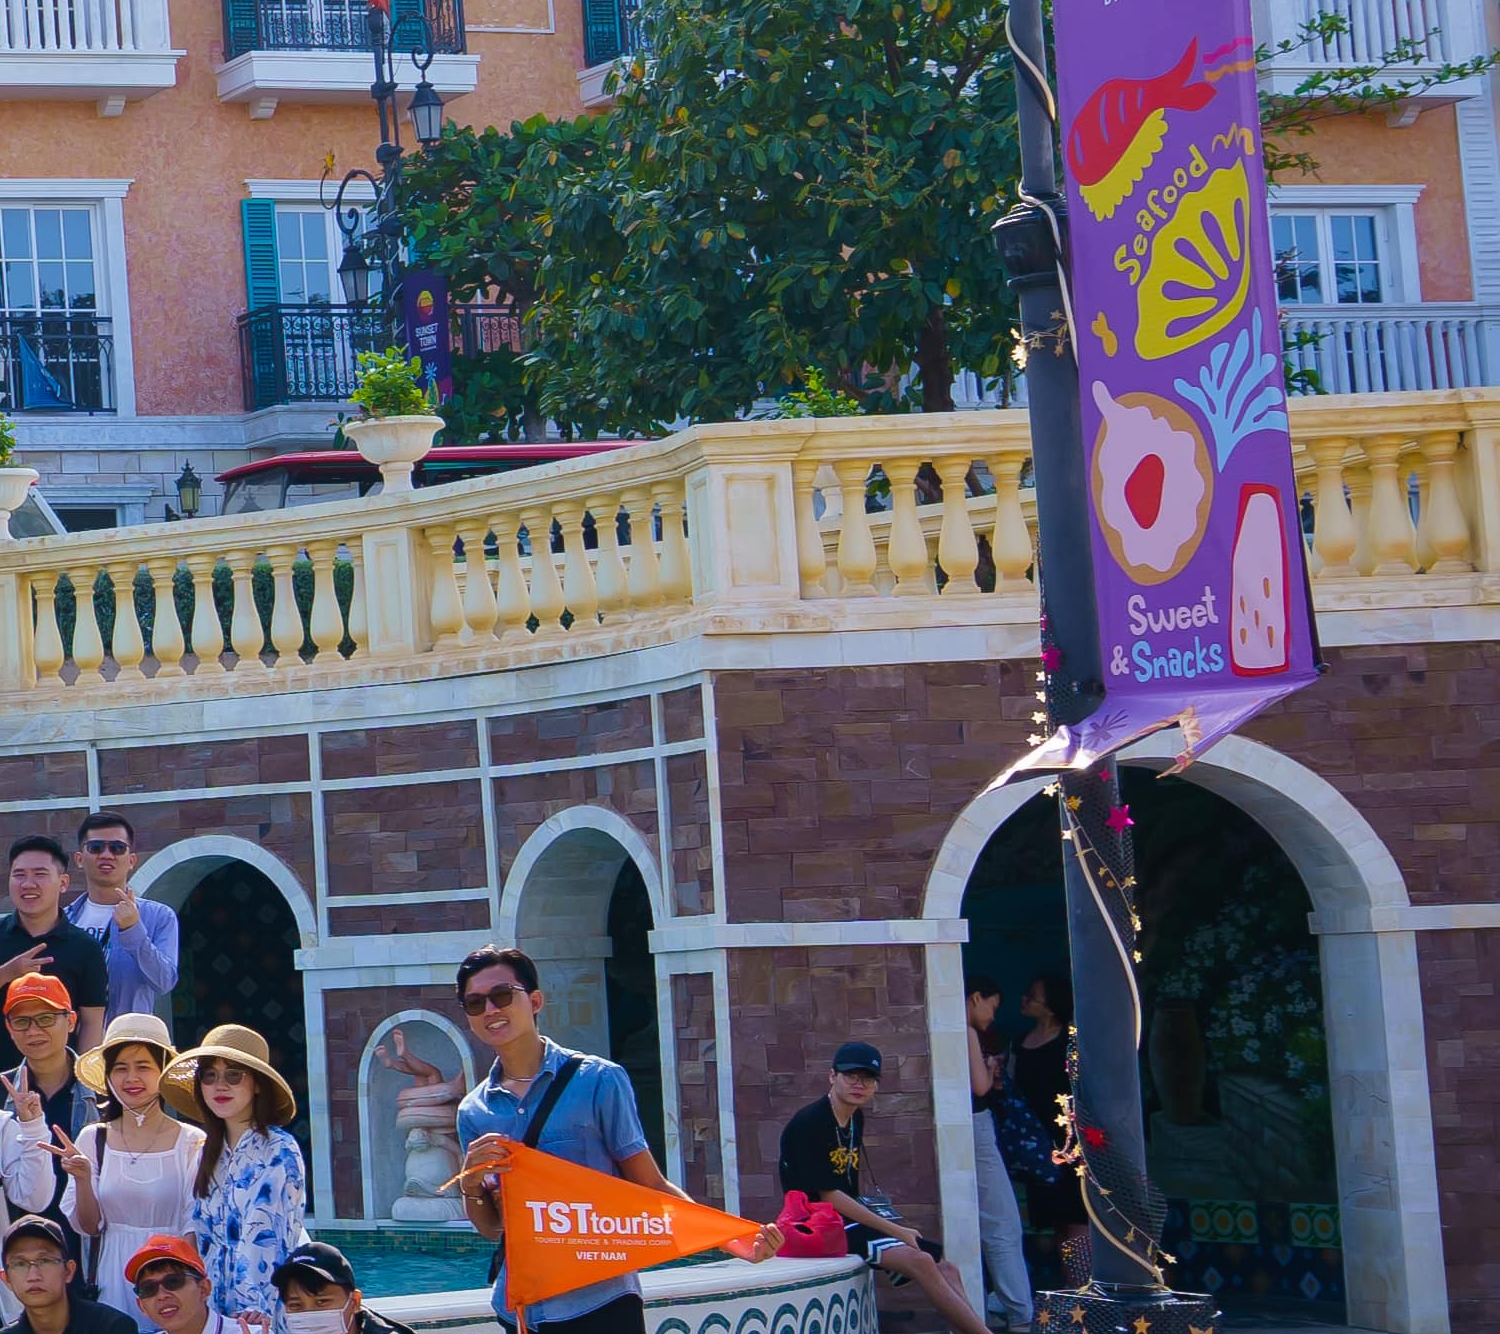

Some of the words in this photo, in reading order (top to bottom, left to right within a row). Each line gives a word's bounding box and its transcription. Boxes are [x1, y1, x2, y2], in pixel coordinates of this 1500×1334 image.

[1114, 143, 1209, 286] Seafood
[1127, 585, 1219, 636] Sweet
[1110, 645, 1130, 676] &
[1131, 636, 1225, 683] Snacks
[576, 1251, 599, 1260] VIET
[601, 1252, 626, 1261] NAM
